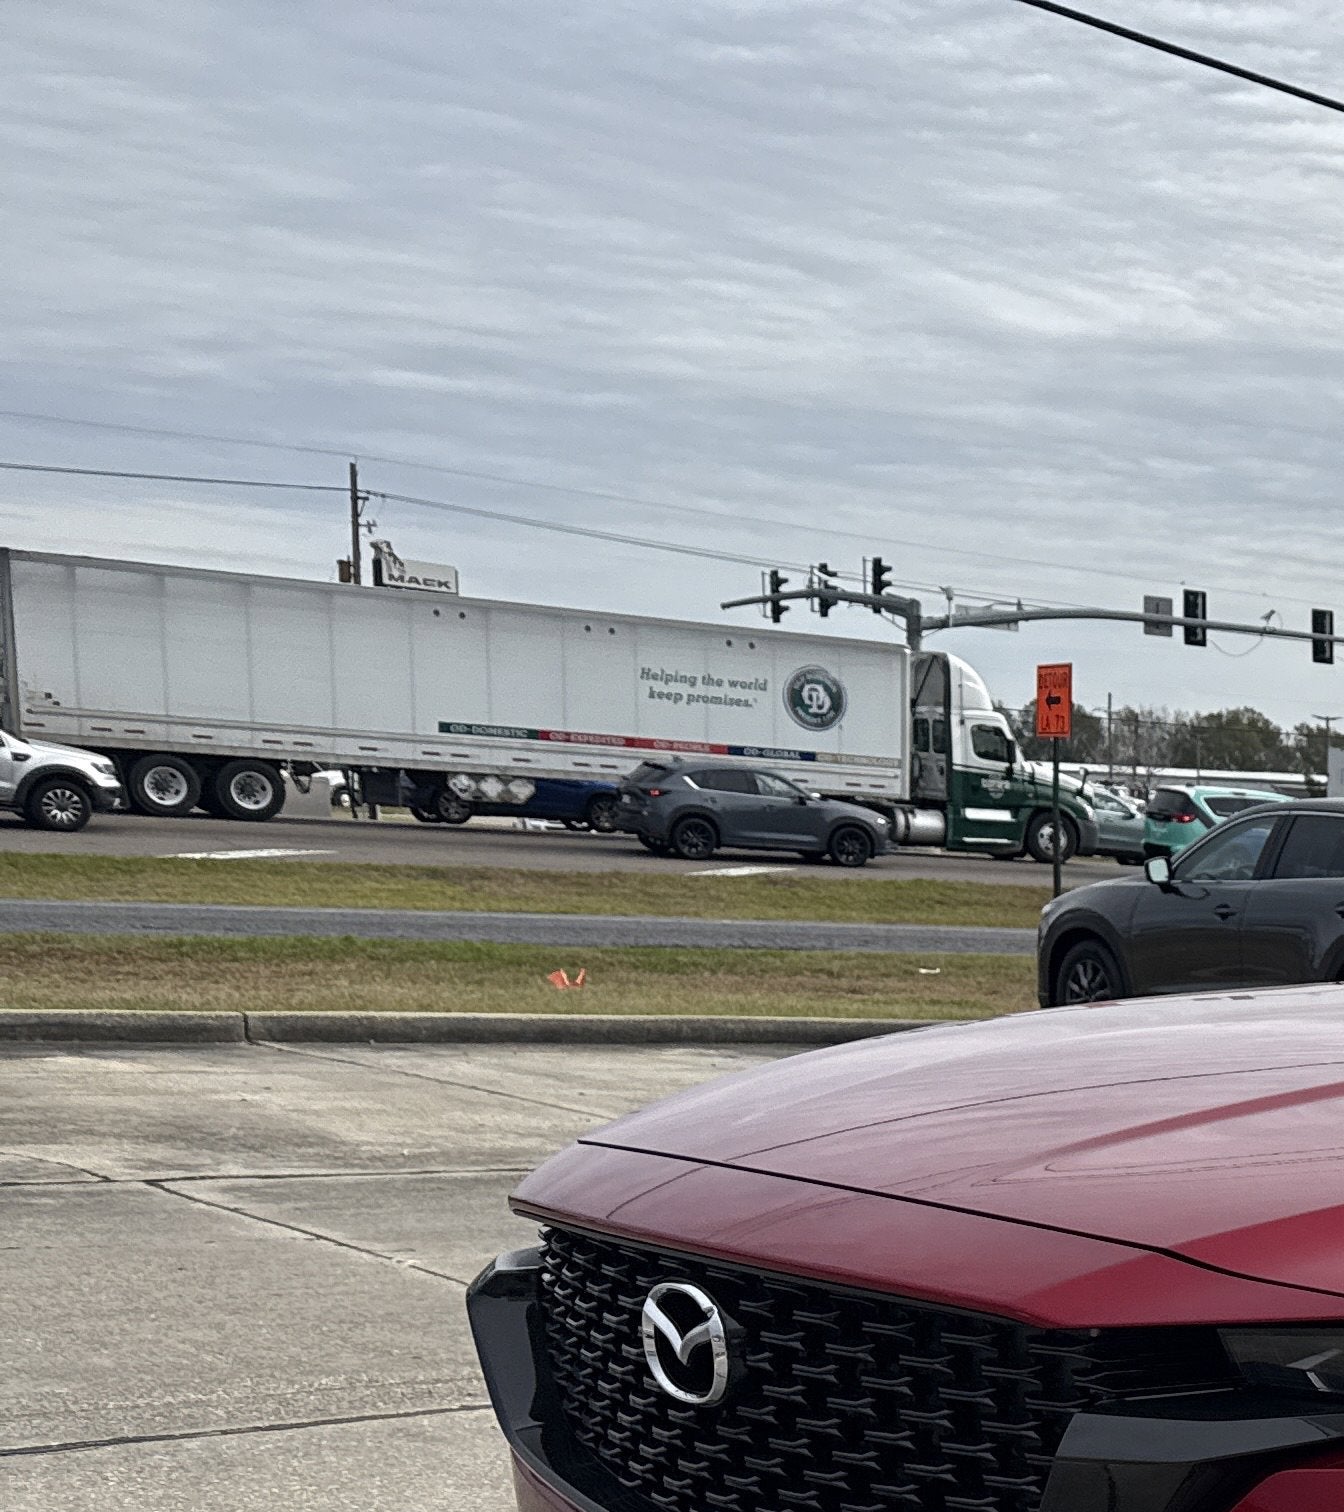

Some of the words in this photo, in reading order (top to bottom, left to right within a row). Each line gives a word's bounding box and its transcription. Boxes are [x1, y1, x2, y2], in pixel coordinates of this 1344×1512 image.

[388, 573, 451, 589] MACK
[640, 667, 697, 687] Helping
[701, 673, 724, 687] the
[727, 679, 768, 691] world
[1039, 671, 1068, 689] DETOUR
[648, 686, 683, 704] keep
[1041, 714, 1050, 730] LA
